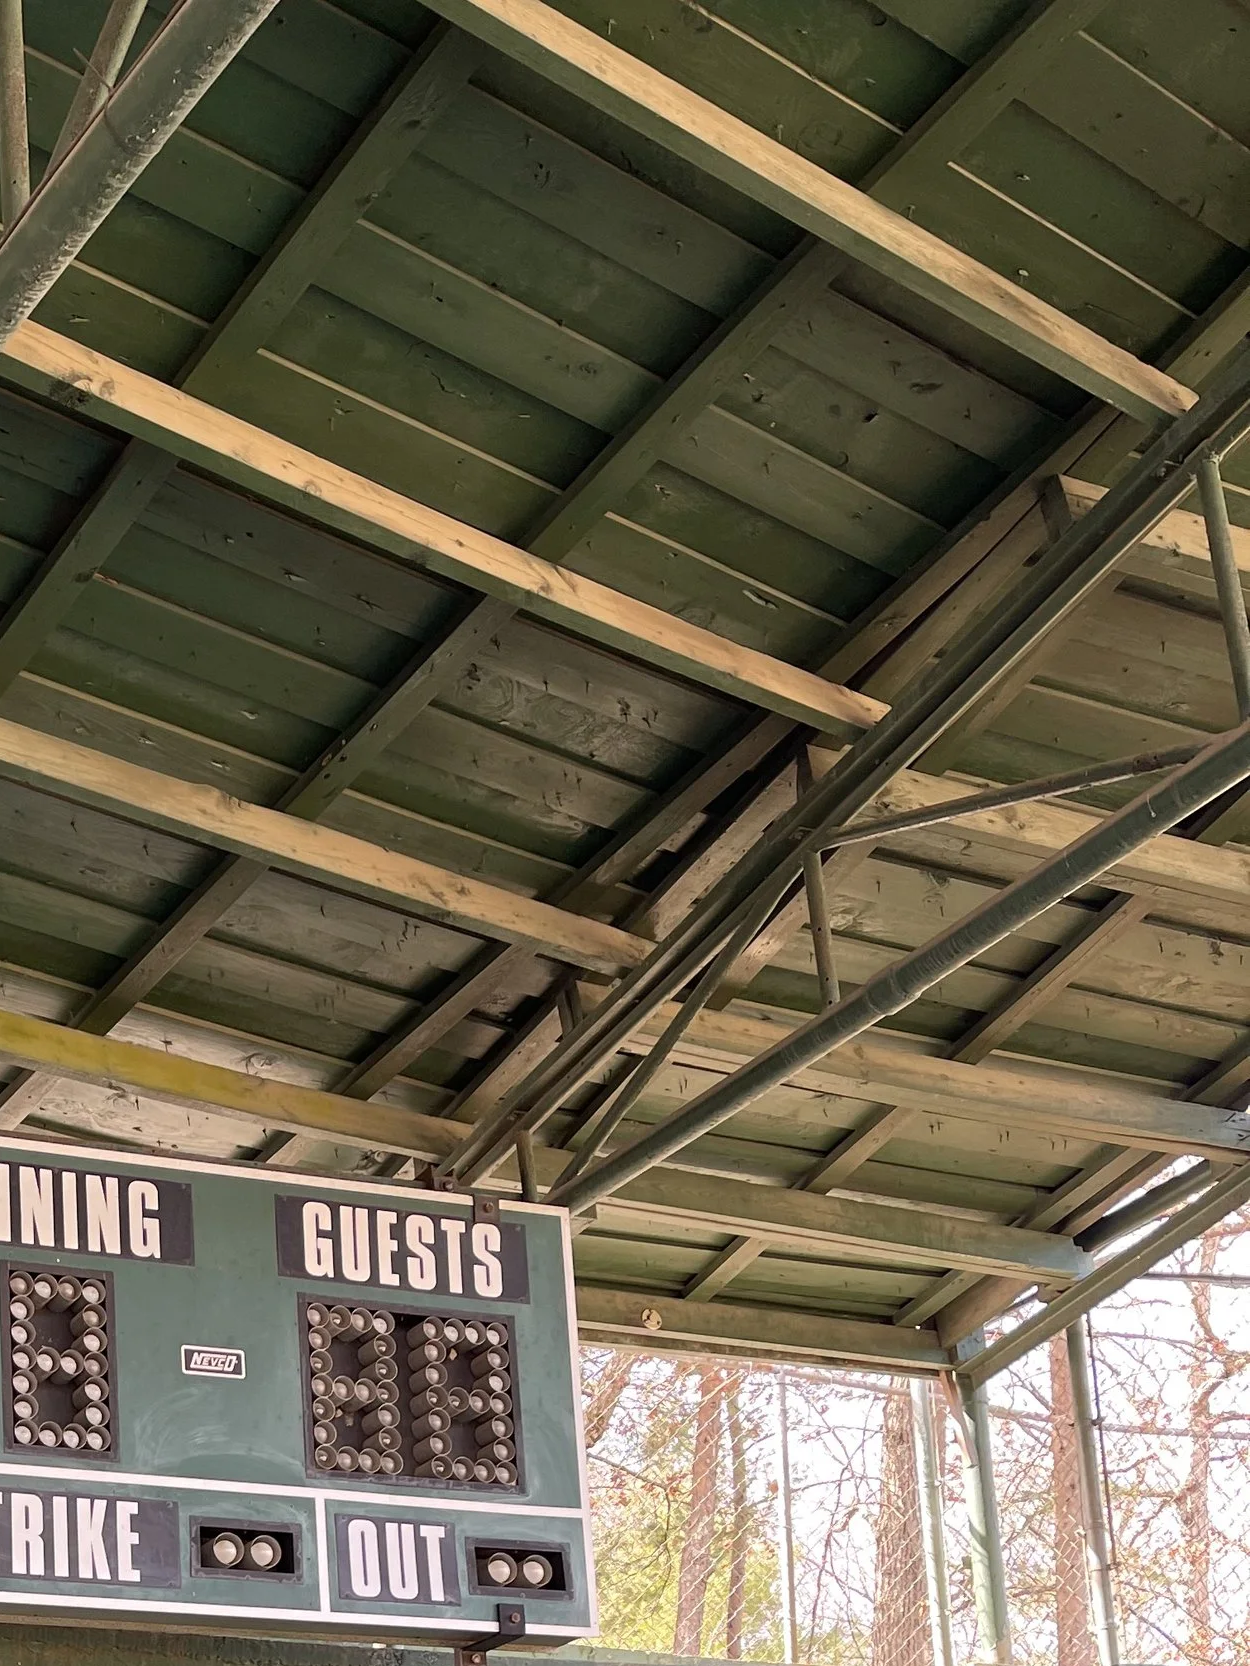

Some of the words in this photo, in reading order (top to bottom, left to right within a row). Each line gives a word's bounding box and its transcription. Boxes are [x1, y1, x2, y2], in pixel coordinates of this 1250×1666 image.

[302, 1201, 503, 1298] GUESTS
[190, 1352, 237, 1371] NEVCO
[347, 1518, 446, 1602] OUT
